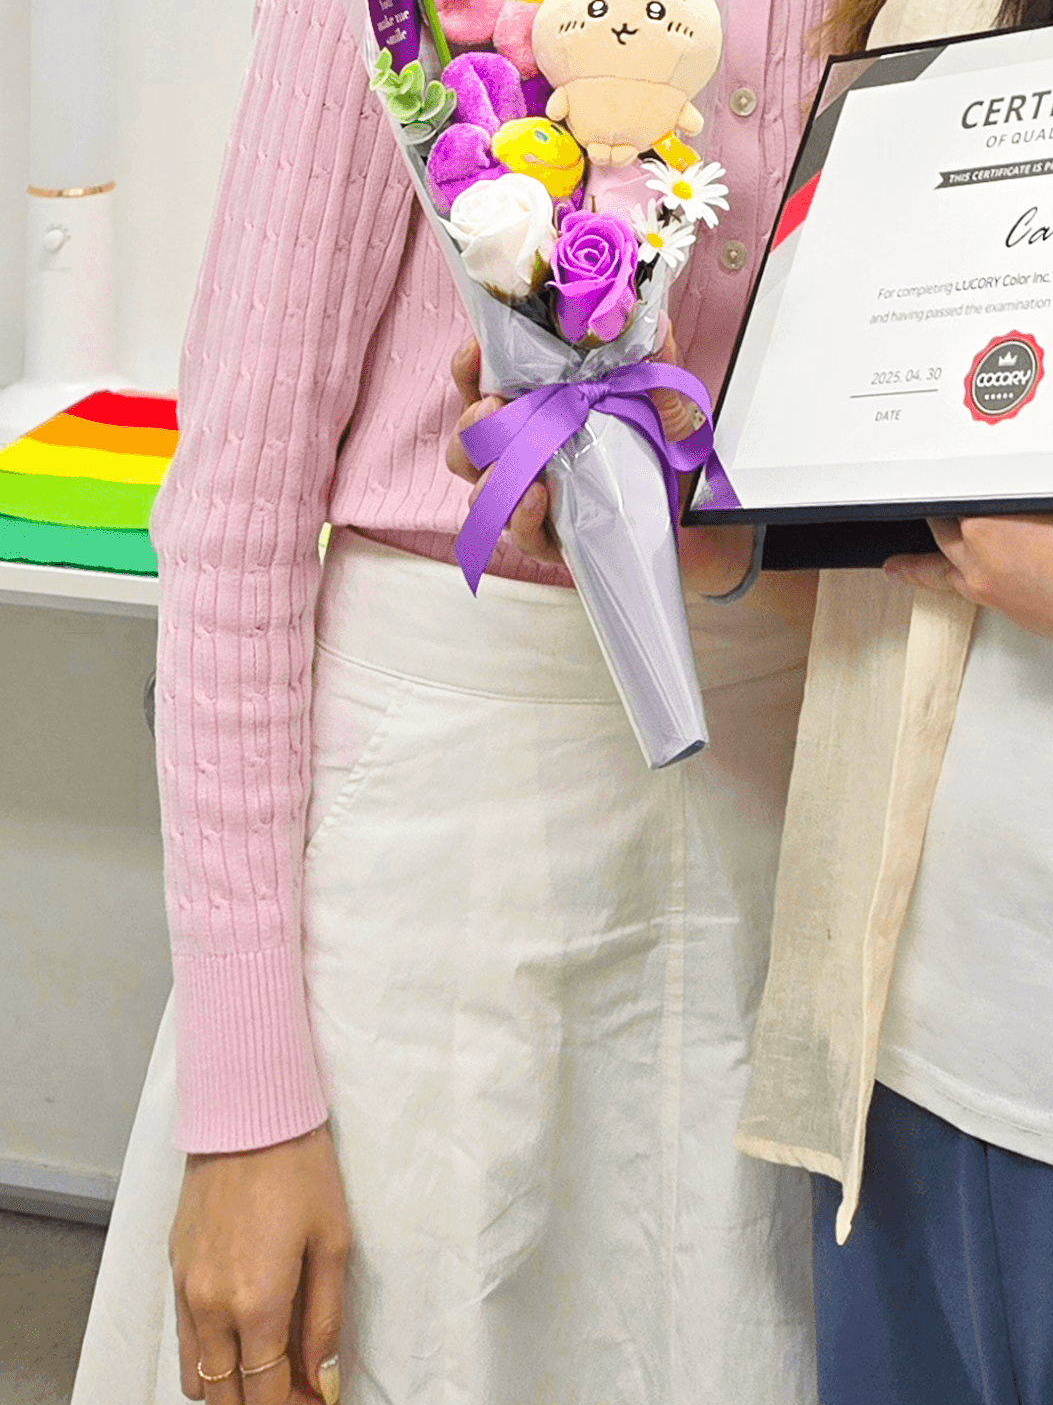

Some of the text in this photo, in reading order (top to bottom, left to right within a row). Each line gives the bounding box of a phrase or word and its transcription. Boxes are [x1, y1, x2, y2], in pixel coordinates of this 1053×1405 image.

[985, 134, 1008, 148] OF
[948, 172, 970, 184] THIS
[971, 165, 1031, 182] CERTIFICATE
[1032, 162, 1043, 173] IS
[877, 288, 896, 300] For
[896, 282, 954, 298] completing
[1002, 272, 1032, 288] Color
[869, 311, 890, 324] and
[890, 309, 924, 323] having
[925, 304, 965, 321] passed
[965, 303, 983, 316] the
[984, 294, 1051, 314] examination
[871, 371, 902, 386] 2025.
[926, 367, 943, 381] 30
[976, 369, 1032, 388] COCORY
[875, 409, 902, 422] DATE
